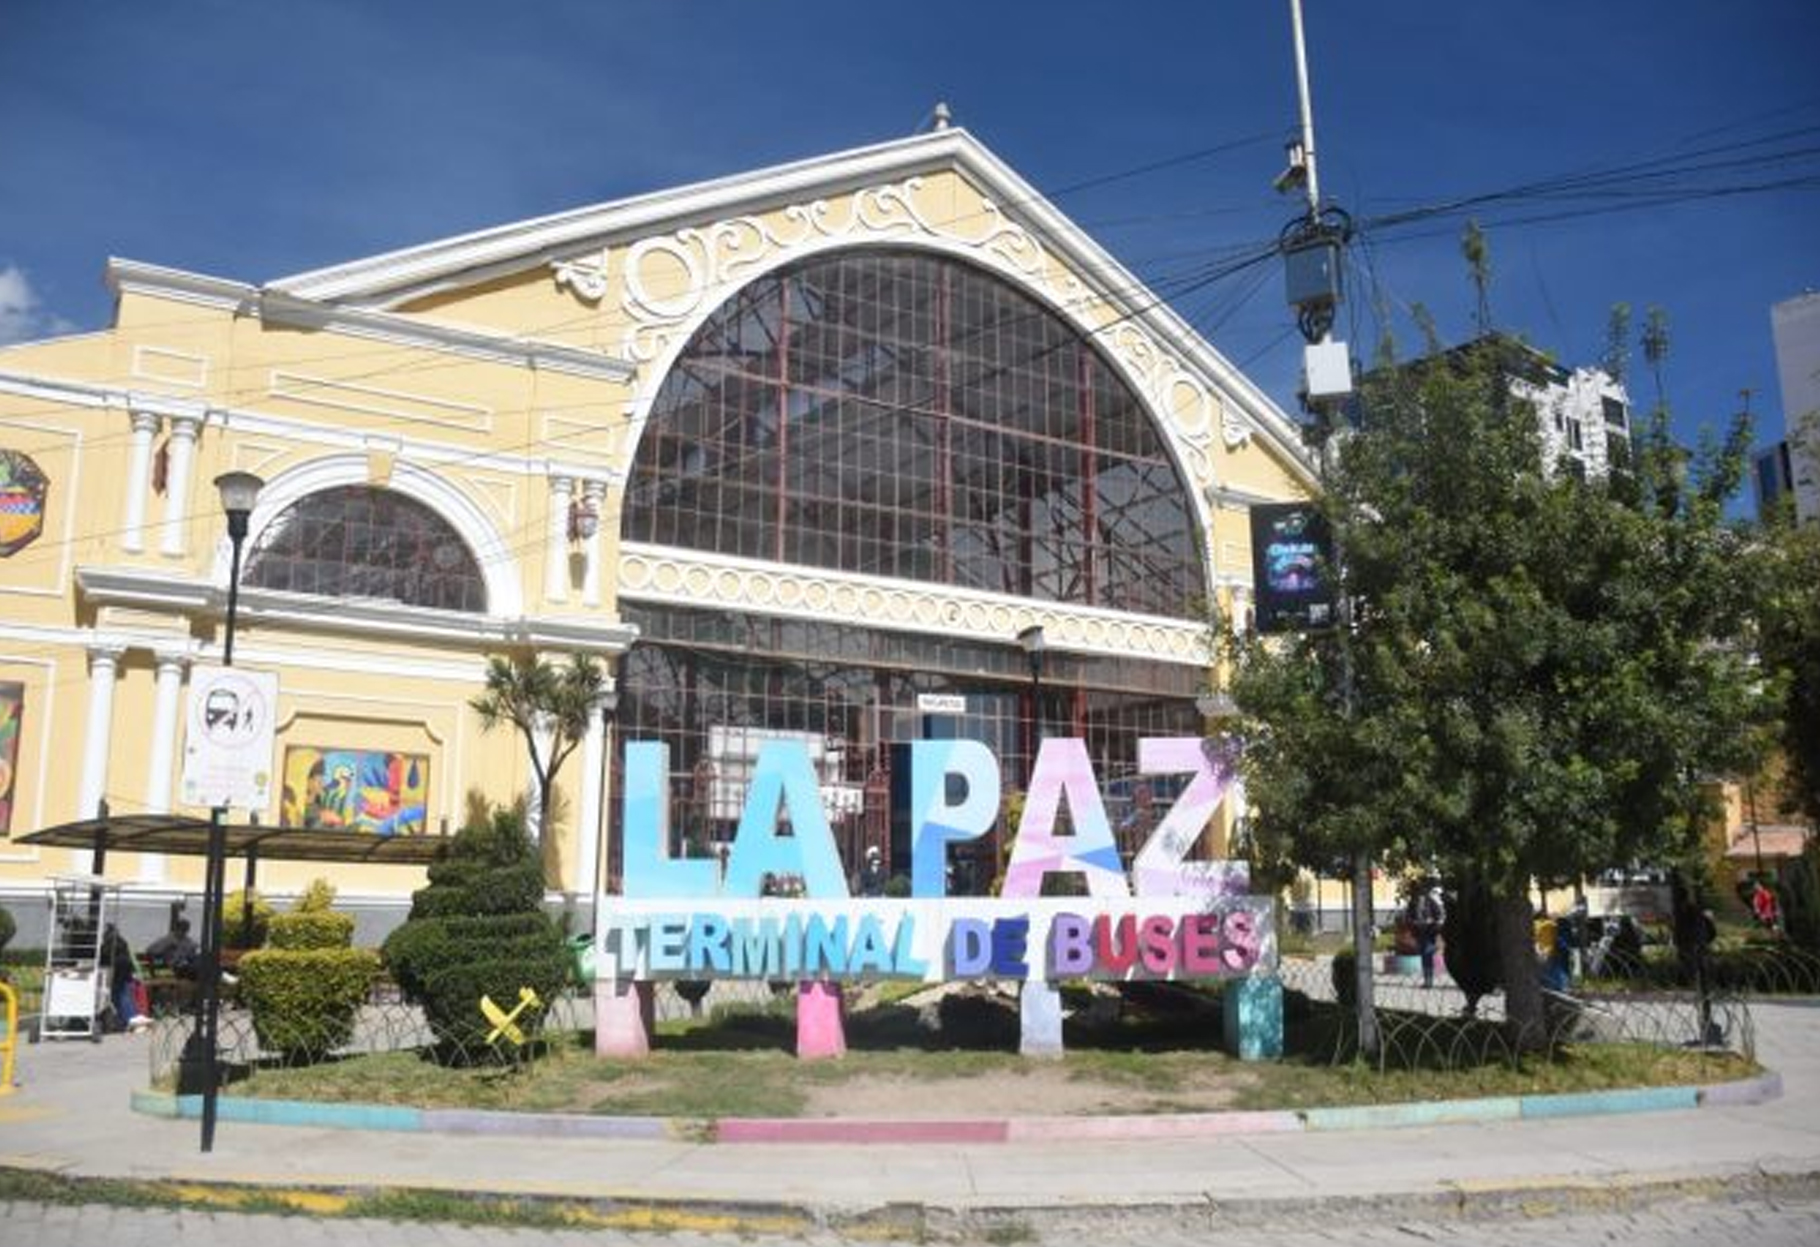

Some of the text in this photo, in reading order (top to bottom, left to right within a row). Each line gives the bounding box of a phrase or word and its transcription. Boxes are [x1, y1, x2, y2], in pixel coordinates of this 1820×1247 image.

[622, 737, 1250, 898] LA PAZ
[606, 911, 1259, 978] TERMINAL DE BUSES
